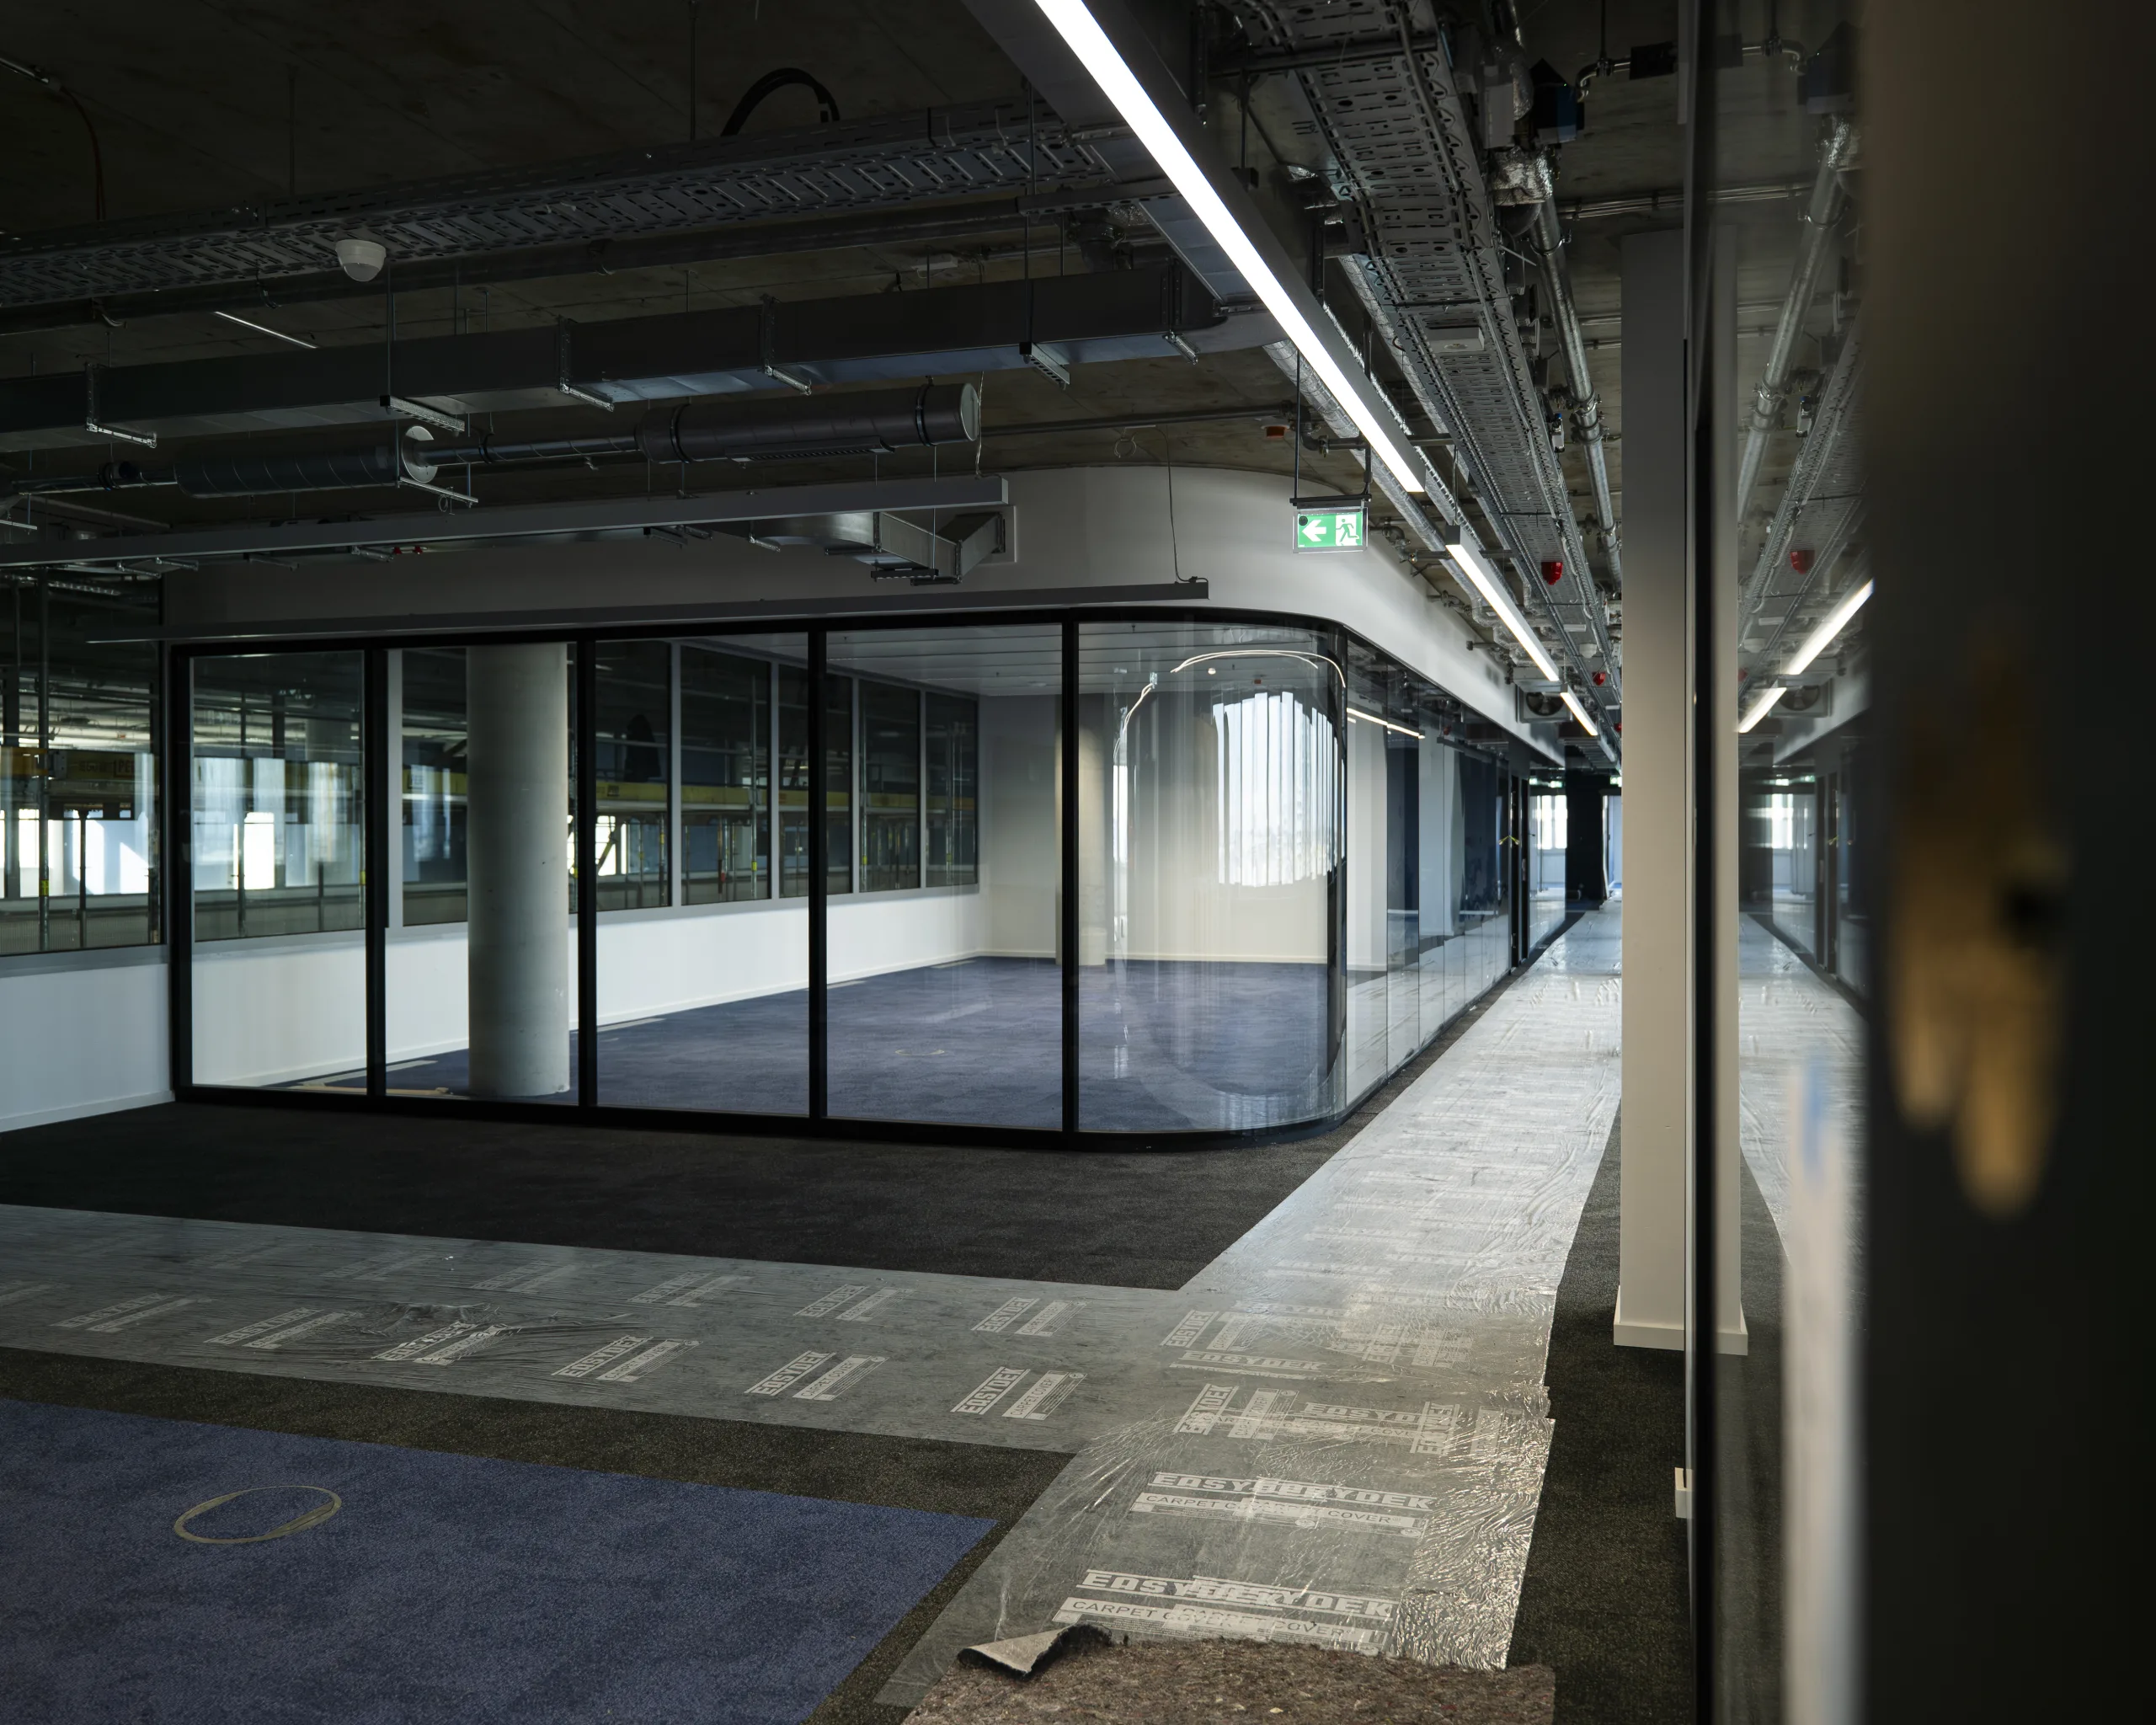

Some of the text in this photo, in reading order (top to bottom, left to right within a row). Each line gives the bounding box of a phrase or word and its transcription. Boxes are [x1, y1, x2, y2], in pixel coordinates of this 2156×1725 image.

[1182, 1351, 1326, 1370] EASYDEK
[750, 1351, 831, 1395] EASYDEK
[956, 1367, 1027, 1413] EASYDEK
[1146, 1495, 1219, 1508] CARPET
[1072, 1601, 1158, 1618] CARPET
